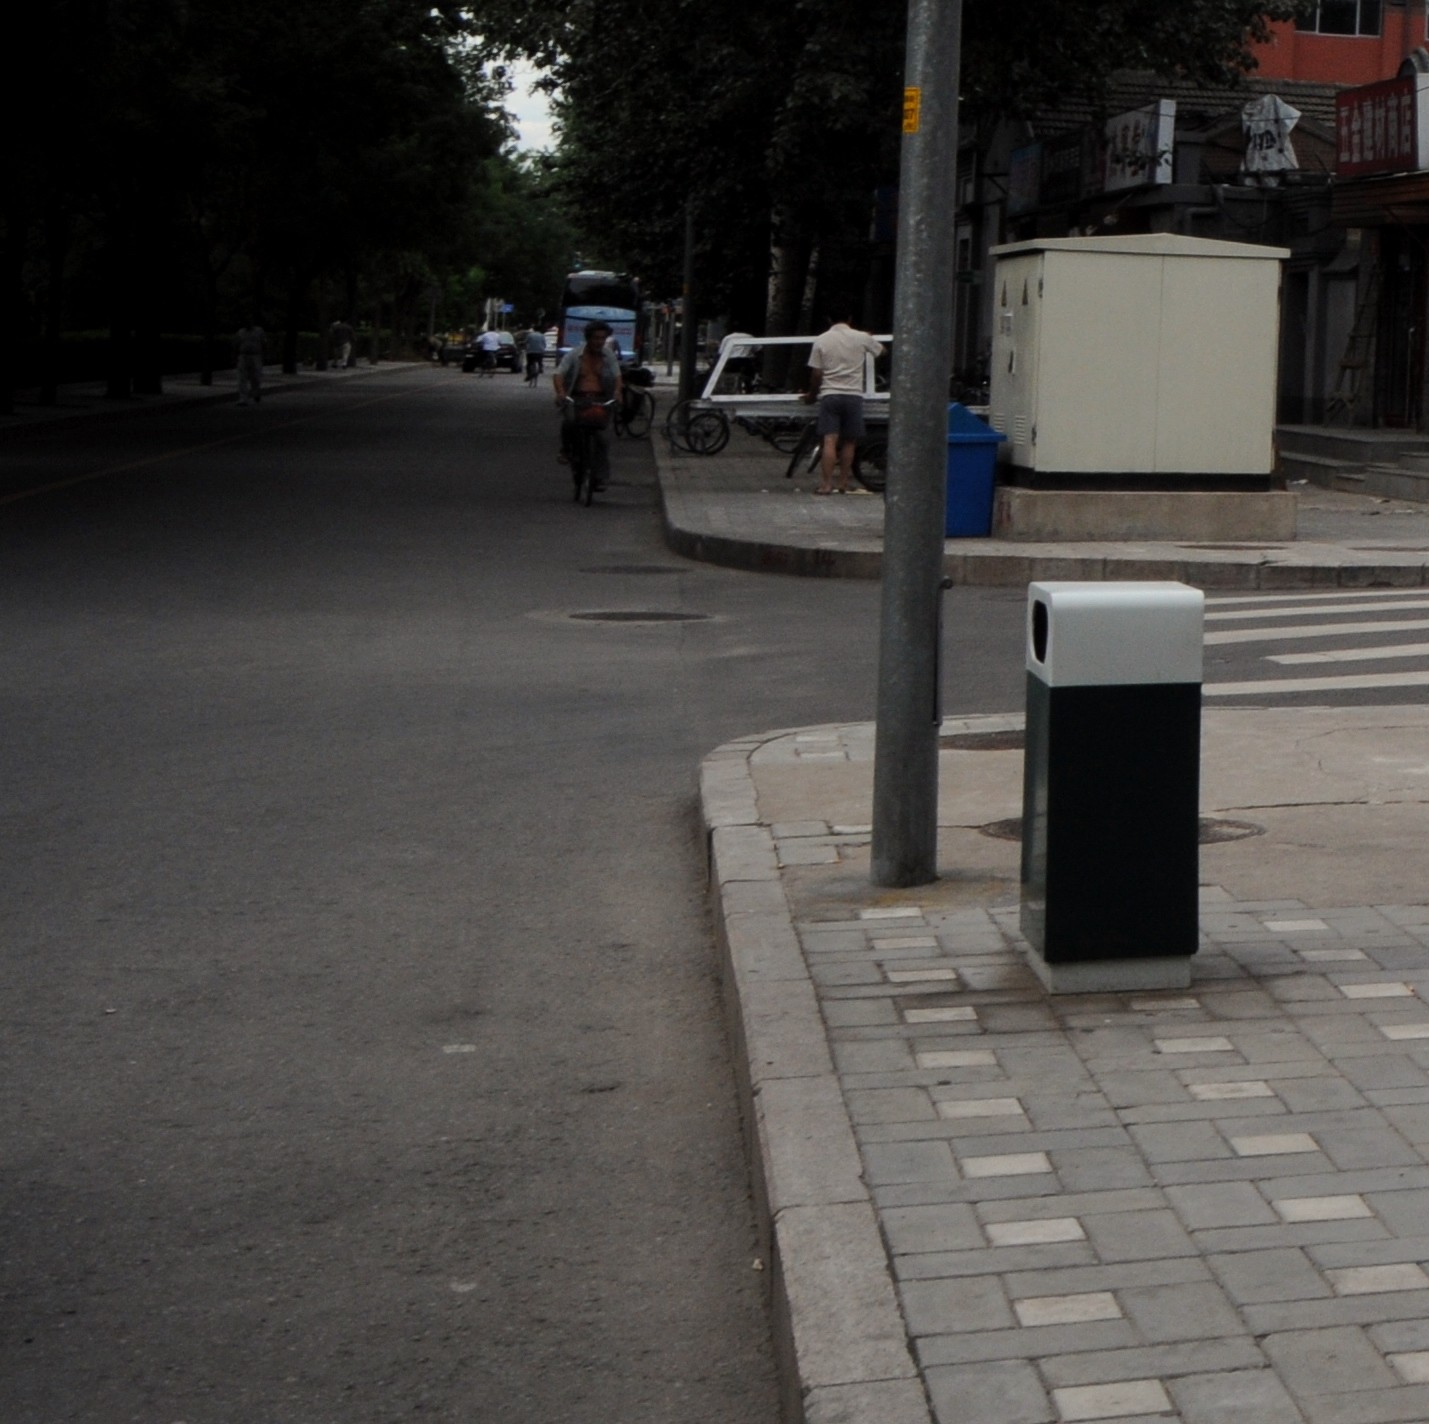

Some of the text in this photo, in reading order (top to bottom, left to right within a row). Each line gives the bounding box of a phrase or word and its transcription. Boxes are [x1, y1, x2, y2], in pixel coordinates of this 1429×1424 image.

[1339, 87, 1412, 163] 五金建材商店
